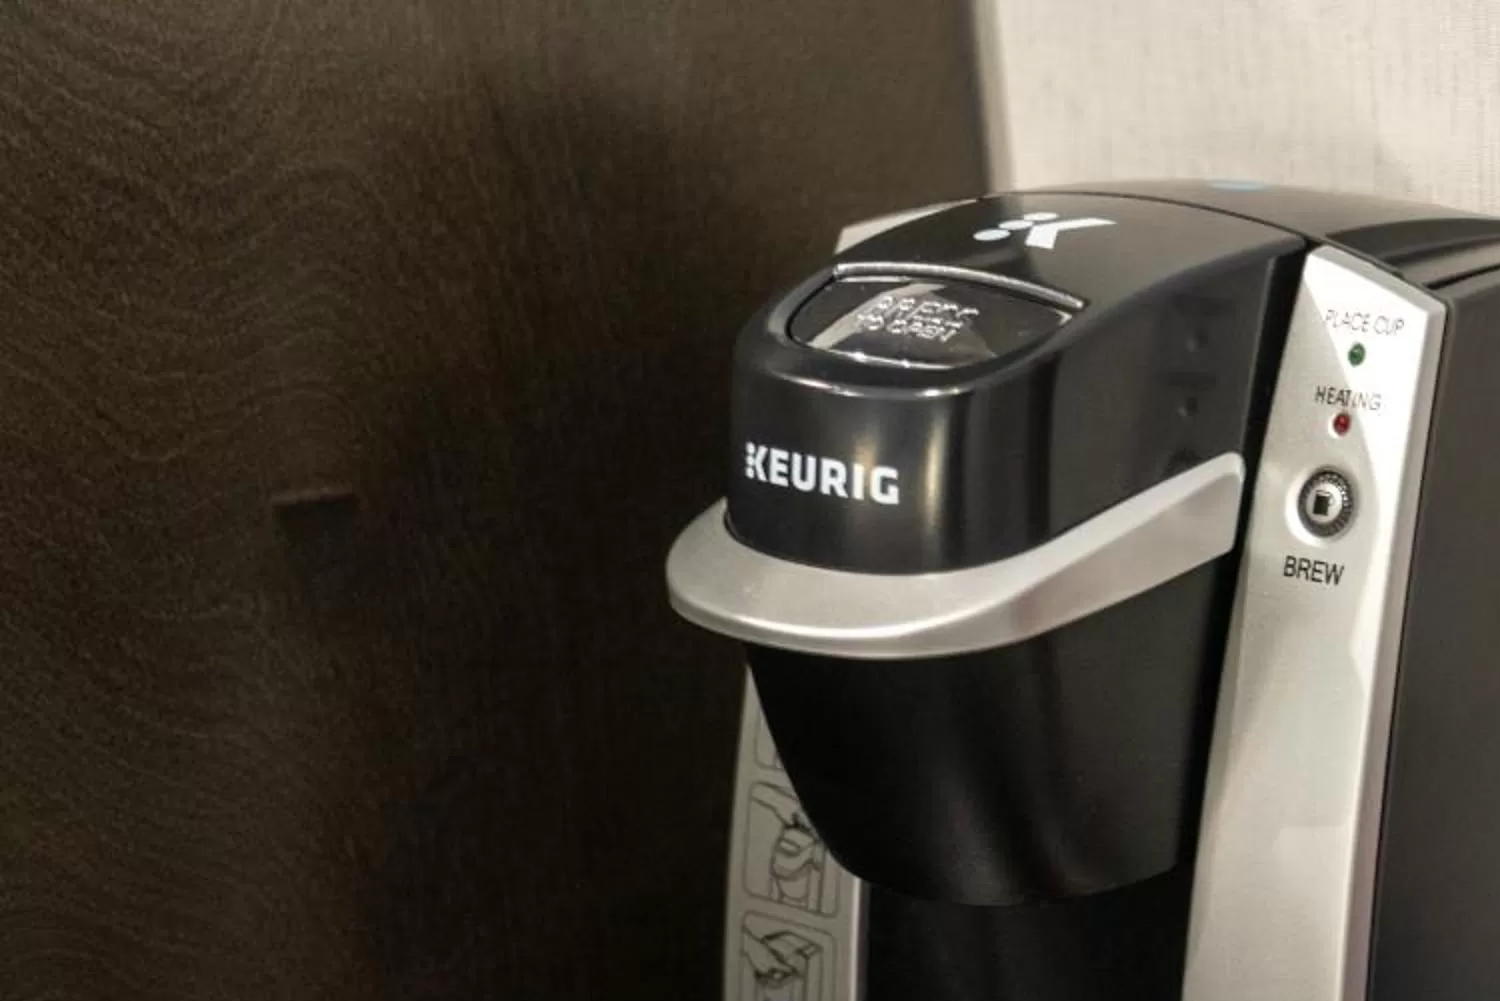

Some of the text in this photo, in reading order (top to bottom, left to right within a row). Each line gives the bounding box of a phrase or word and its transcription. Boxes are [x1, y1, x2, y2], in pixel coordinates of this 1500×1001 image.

[1325, 308, 1405, 336] PLACE CUP
[1314, 385, 1382, 411] HEATING
[745, 441, 900, 505] KEURIG
[1283, 555, 1345, 586] BREW
